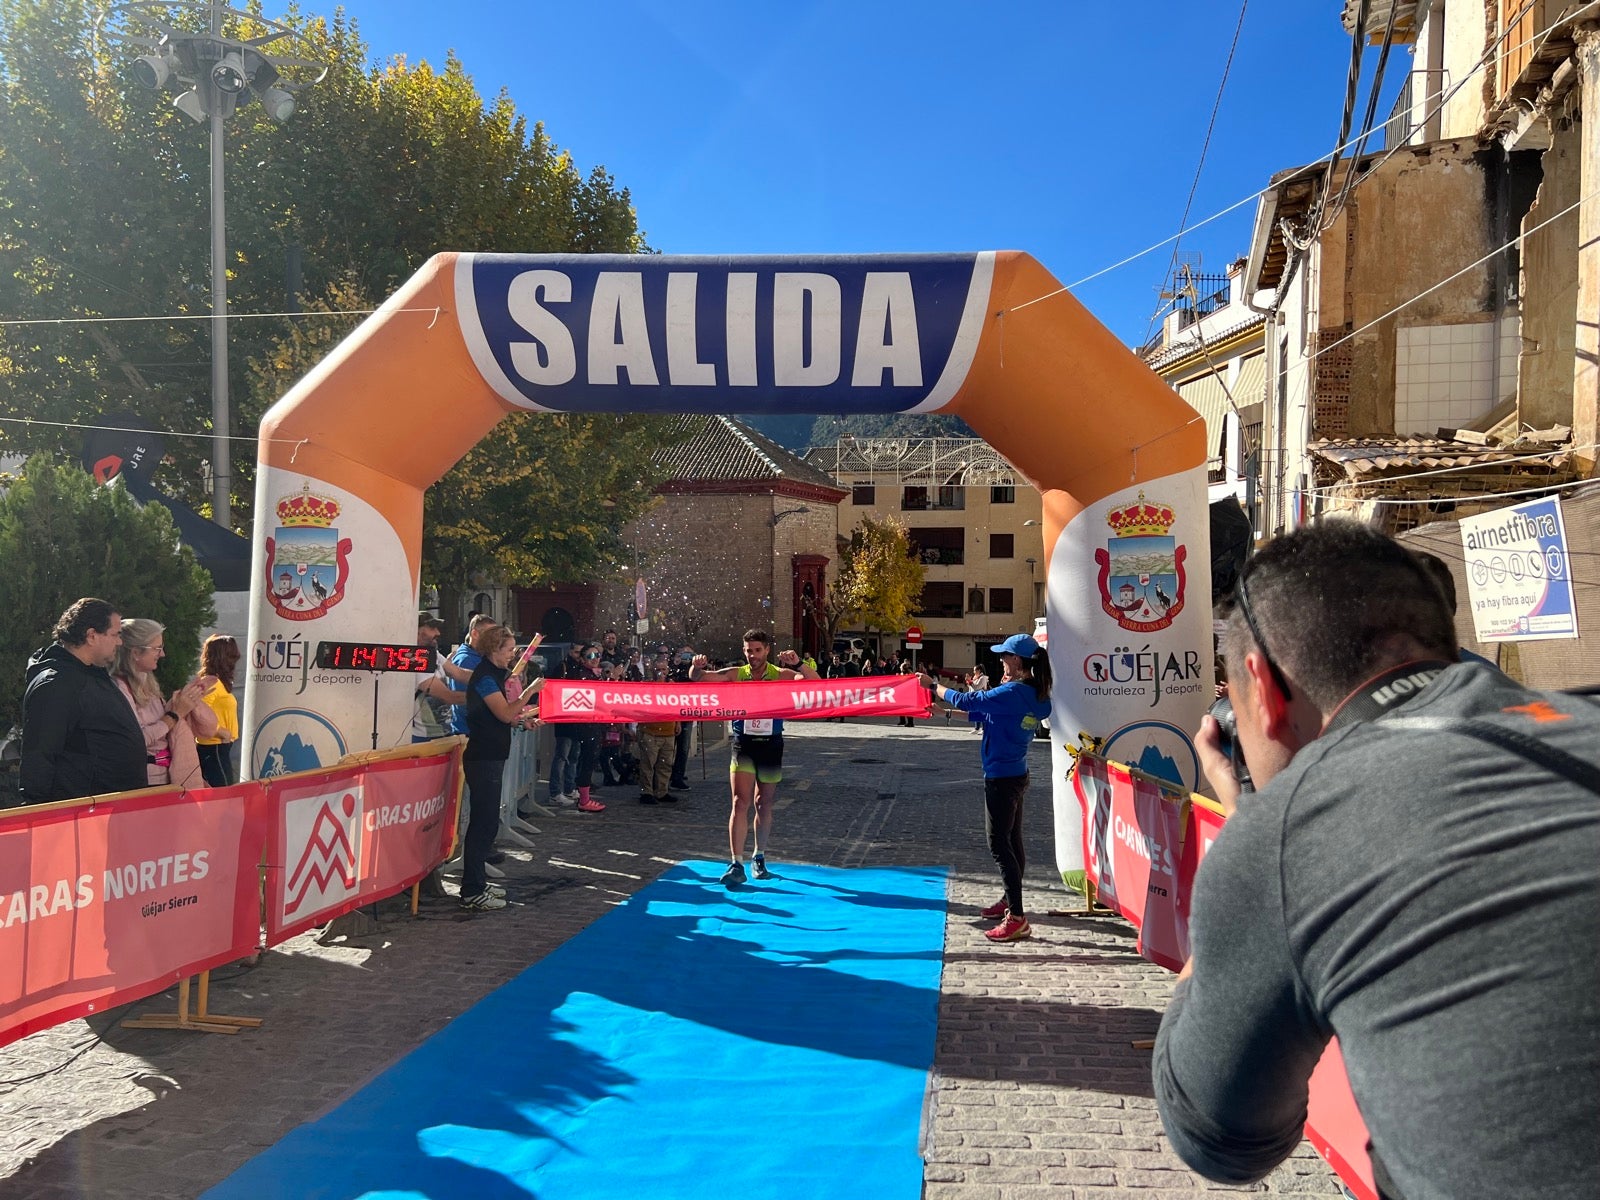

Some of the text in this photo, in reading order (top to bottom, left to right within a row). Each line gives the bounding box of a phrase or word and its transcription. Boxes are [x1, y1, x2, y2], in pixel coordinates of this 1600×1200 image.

[507, 269, 924, 387] SALIDA
[1466, 513, 1558, 551] airnetfibra
[1475, 591, 1537, 611] ya hay fibra aquí
[252, 632, 318, 695] GÜÉJ
[334, 646, 428, 671] 11:47:55
[312, 672, 362, 686] deporte
[1083, 644, 1201, 708] GÜÉJAR
[1371, 669, 1440, 705] non
[602, 692, 720, 707] CARAS NORTES
[791, 686, 897, 710] WINNER
[1084, 683, 1203, 697] naturaleza deporte
[679, 706, 747, 718] Güéjar Sierra
[751, 719, 761, 729] 62
[365, 802, 411, 832] CARAS
[103, 849, 210, 903] NORTES
[1149, 884, 1168, 898] erra
[141, 894, 199, 918] Güéjar Sierra
